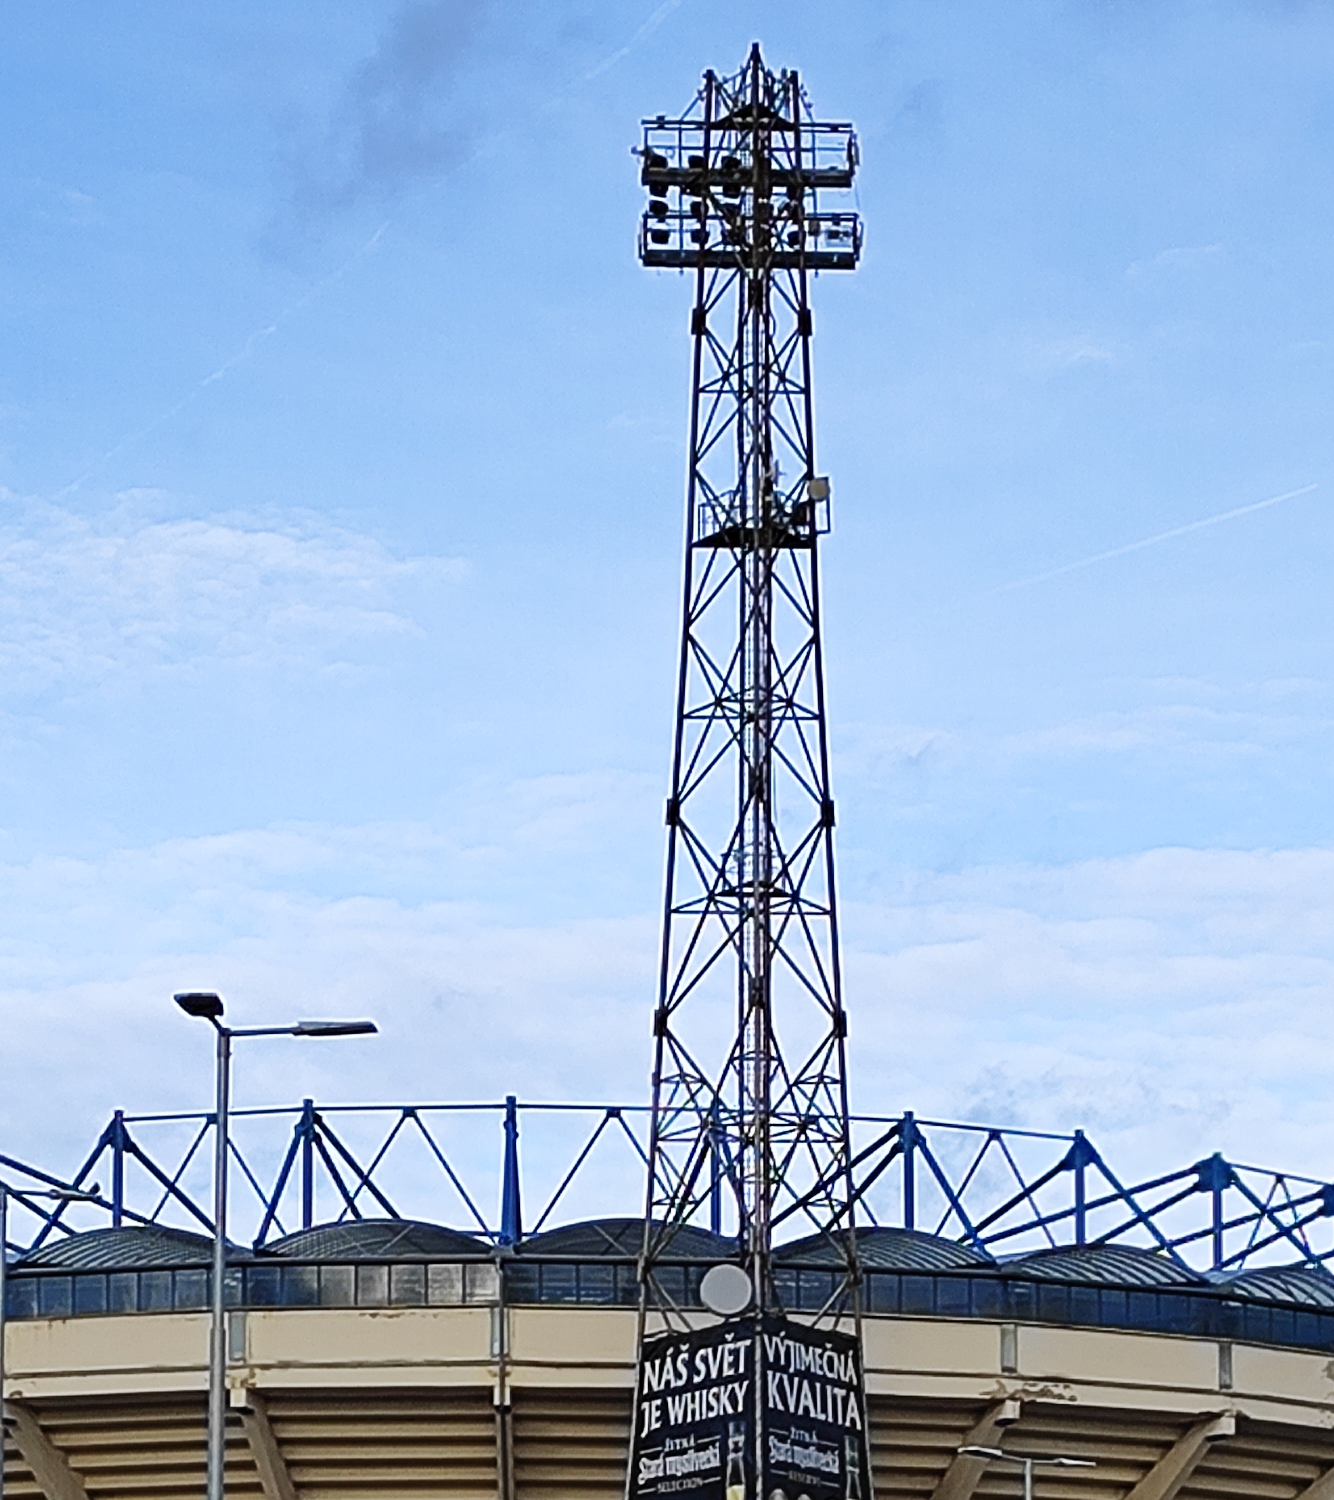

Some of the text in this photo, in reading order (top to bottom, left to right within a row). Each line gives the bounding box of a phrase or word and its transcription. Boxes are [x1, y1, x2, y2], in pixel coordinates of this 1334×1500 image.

[642, 1333, 752, 1395] NÁŠ SVĚT
[763, 1331, 857, 1385] VÝJIMEČNÁ
[640, 1380, 749, 1438] JE WHISKY
[767, 1370, 861, 1430] KVALITA
